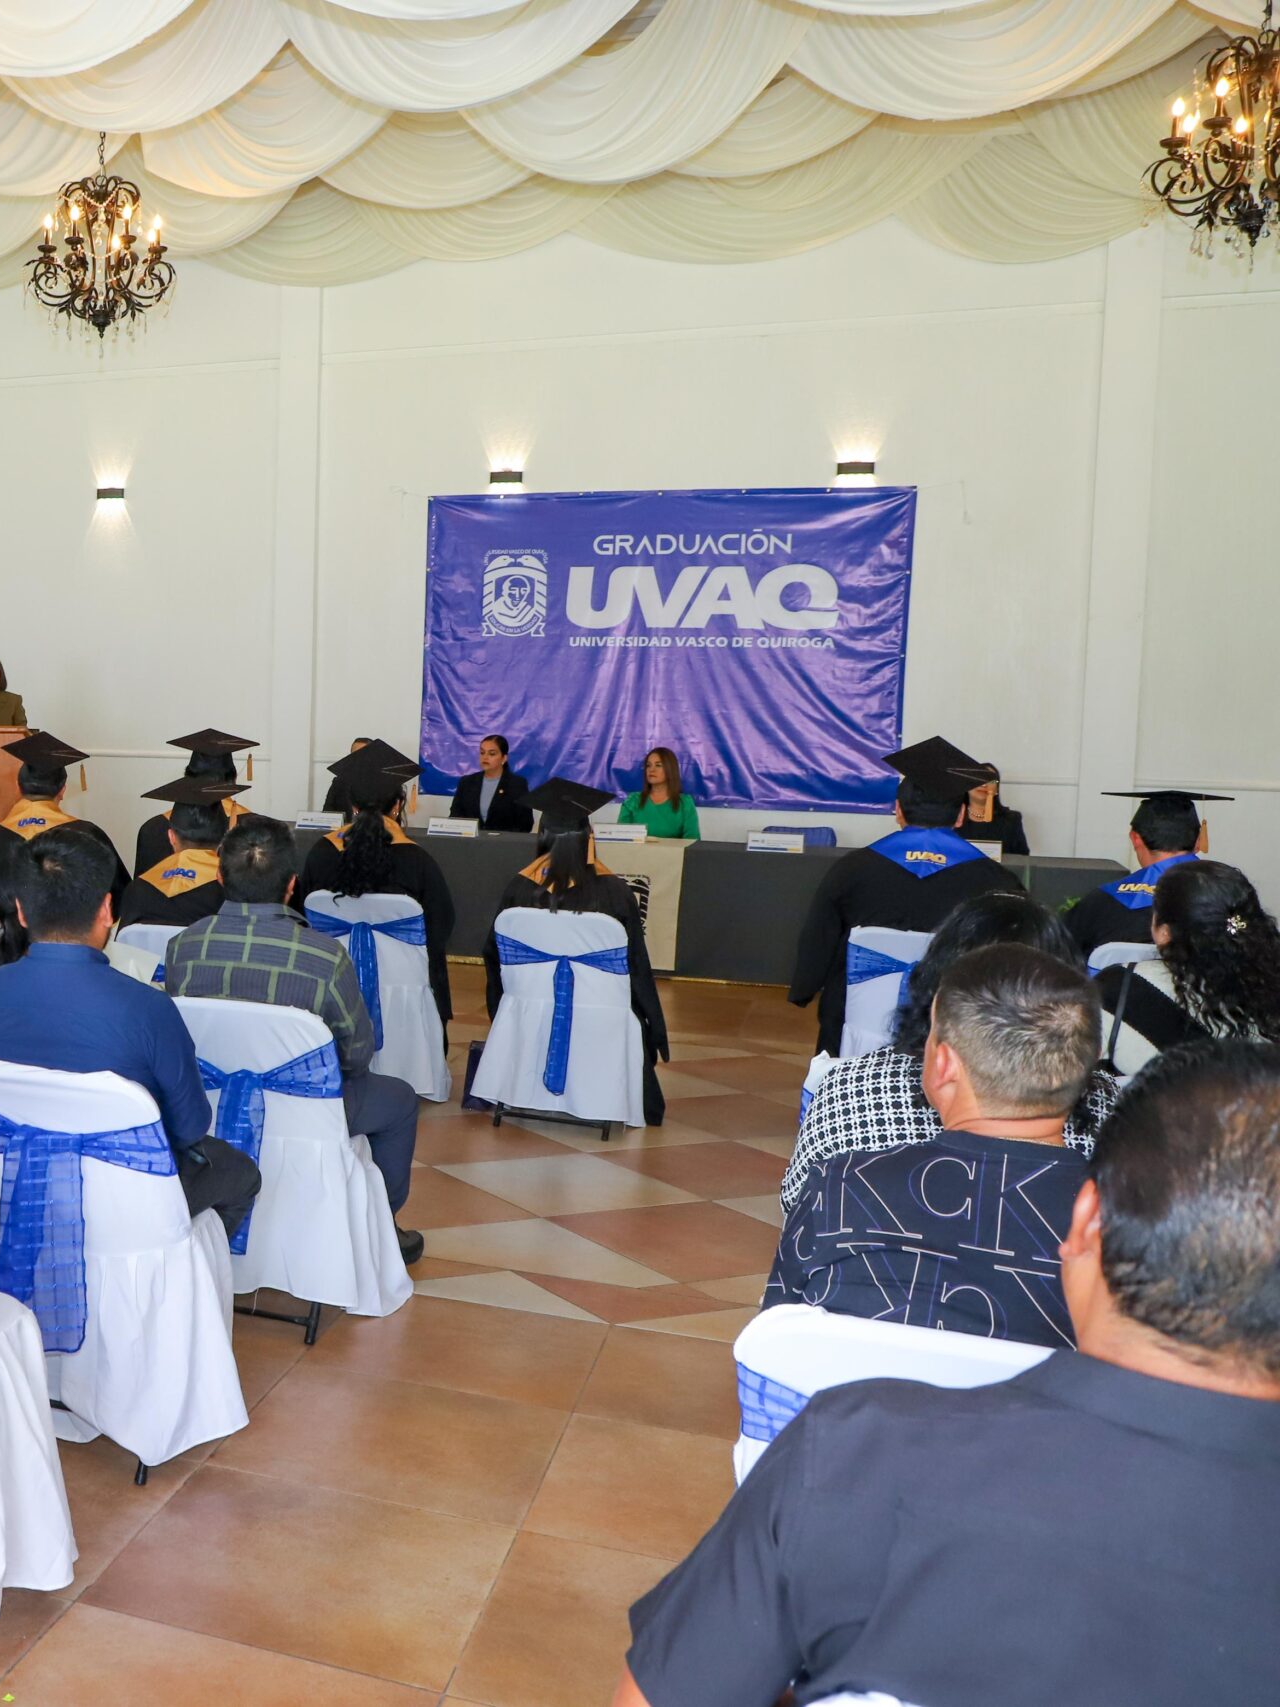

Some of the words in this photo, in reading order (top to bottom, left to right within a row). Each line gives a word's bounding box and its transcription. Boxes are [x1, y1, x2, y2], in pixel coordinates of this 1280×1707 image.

[565, 563, 840, 630] UVAQ
[569, 636, 674, 648] UNIVERSIDAD
[675, 636, 729, 648] VASCO
[731, 637, 754, 648] DE
[756, 637, 835, 649] QUIROGA
[17, 817, 46, 827] UVAQ
[905, 850, 947, 864] UVAQ
[162, 867, 196, 879] UVAQ
